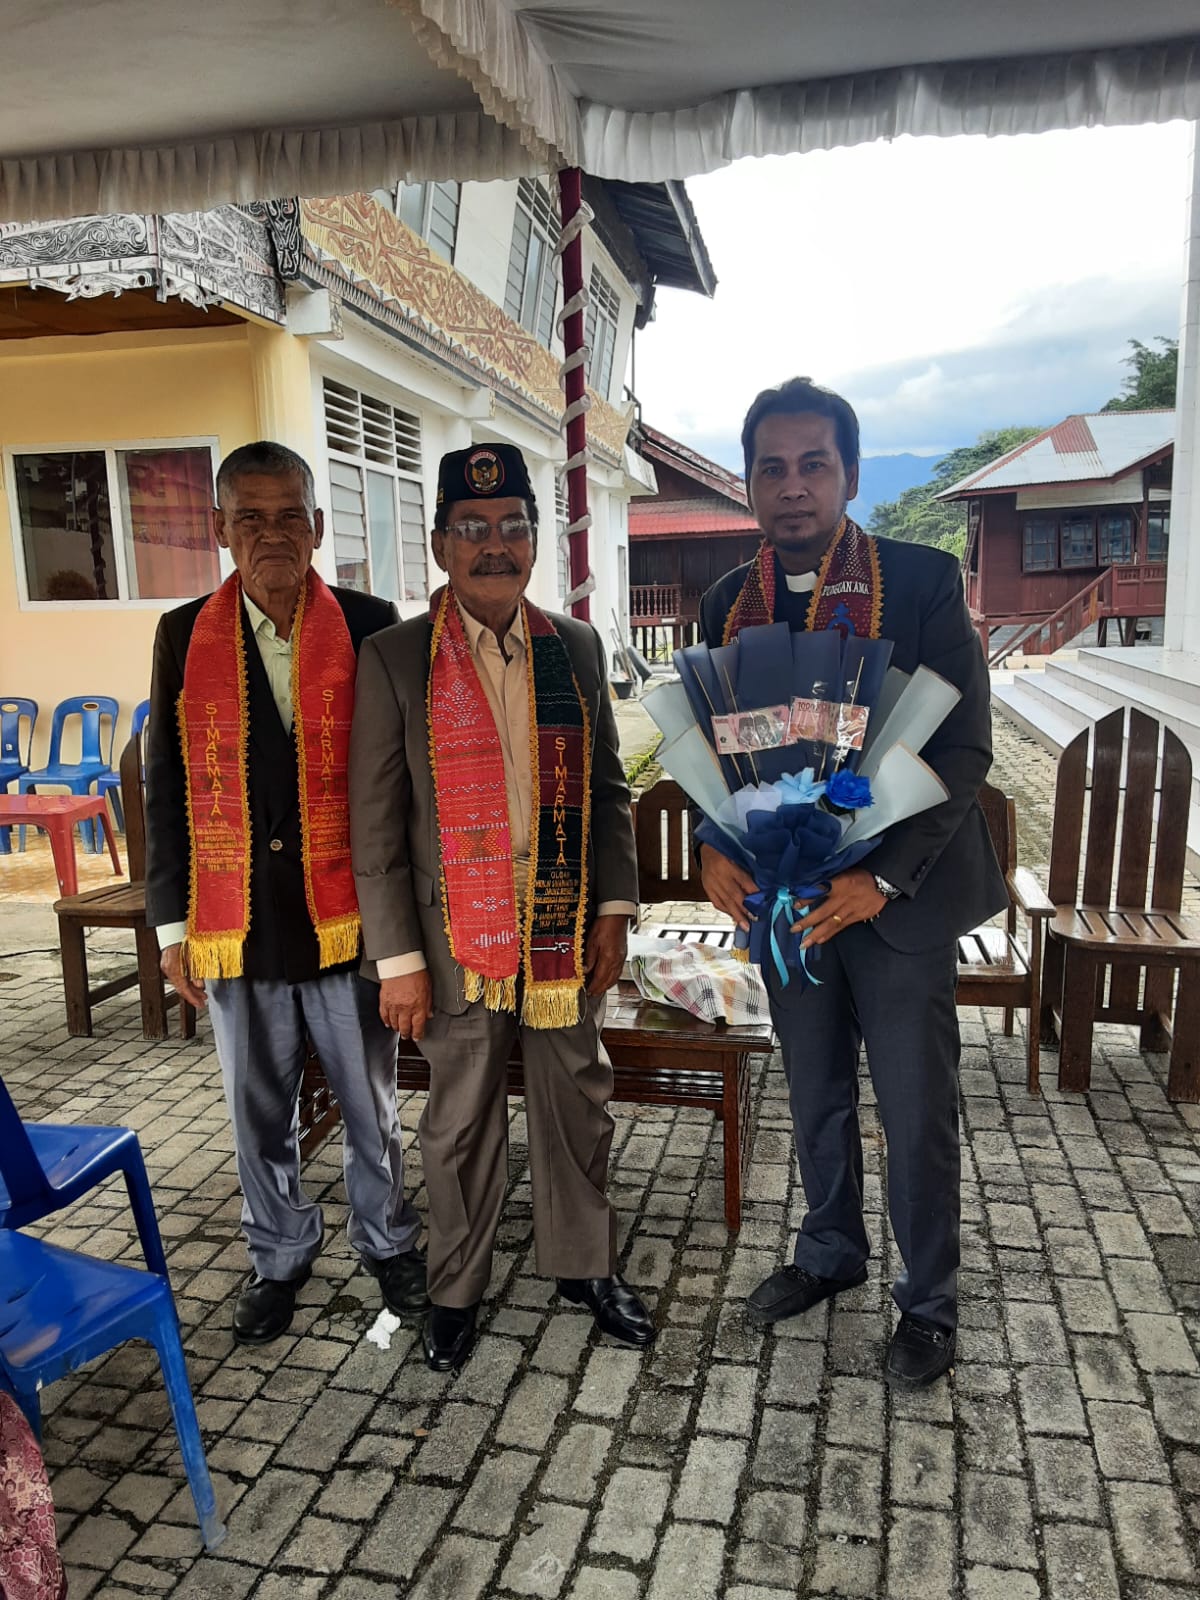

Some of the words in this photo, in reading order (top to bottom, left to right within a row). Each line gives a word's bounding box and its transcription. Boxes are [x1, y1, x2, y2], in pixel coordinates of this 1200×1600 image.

[205, 702, 223, 816] SIMARMATA
[320, 689, 335, 802] SIMARMATA
[553, 736, 568, 866] SIMARMATA
